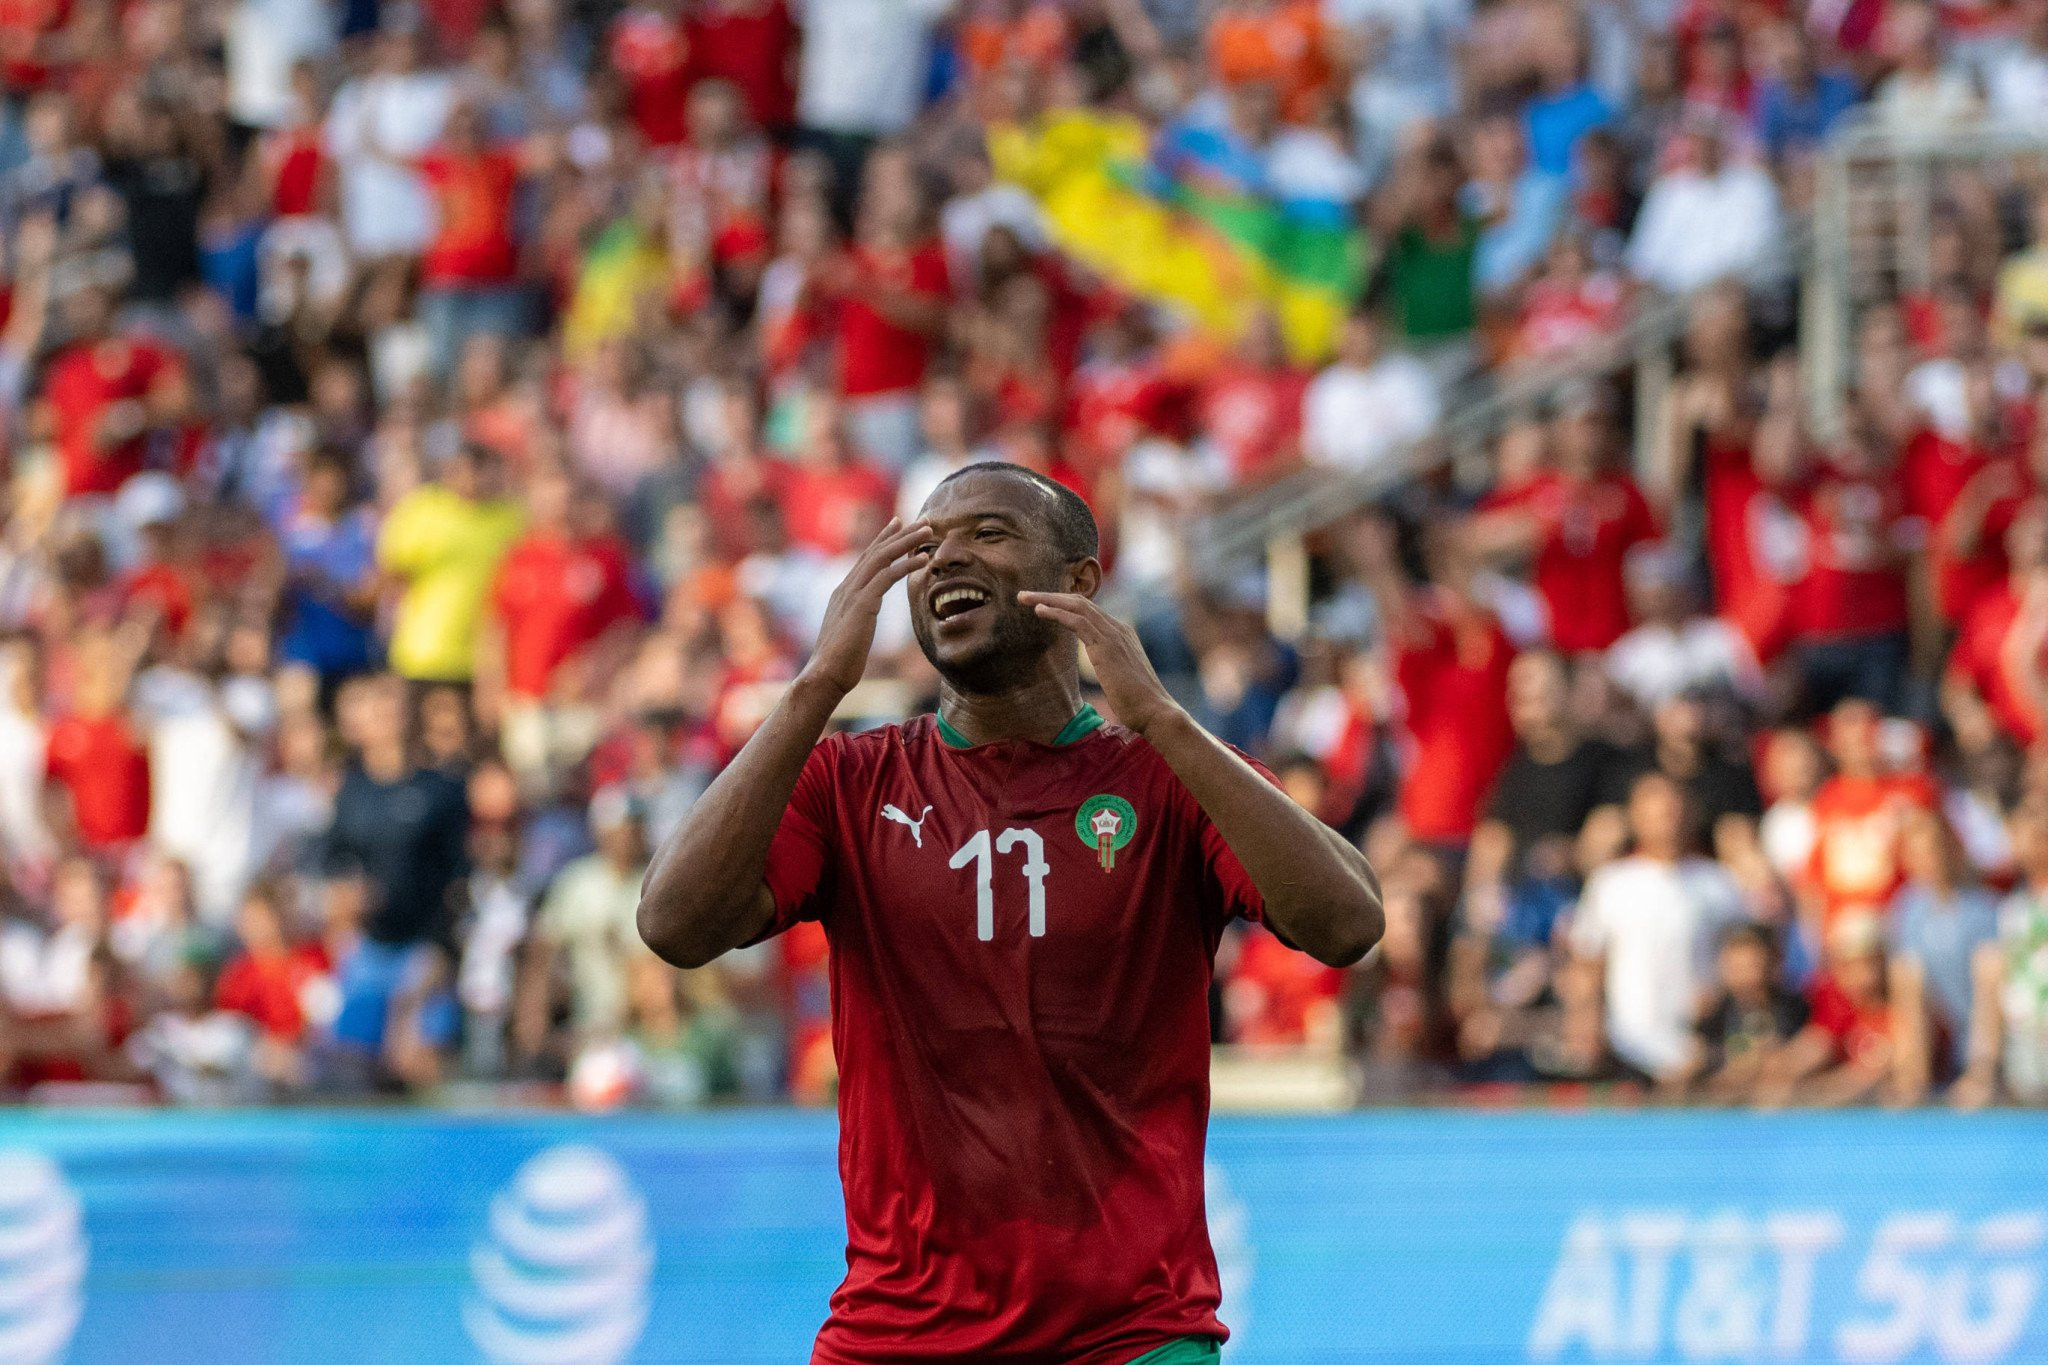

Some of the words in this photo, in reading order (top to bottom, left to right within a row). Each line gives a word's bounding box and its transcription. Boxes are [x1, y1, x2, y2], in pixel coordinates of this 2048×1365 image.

[949, 828, 1050, 941] 17
[1530, 1211, 1843, 1360] AT&T
[1836, 1211, 2044, 1361] 5G
